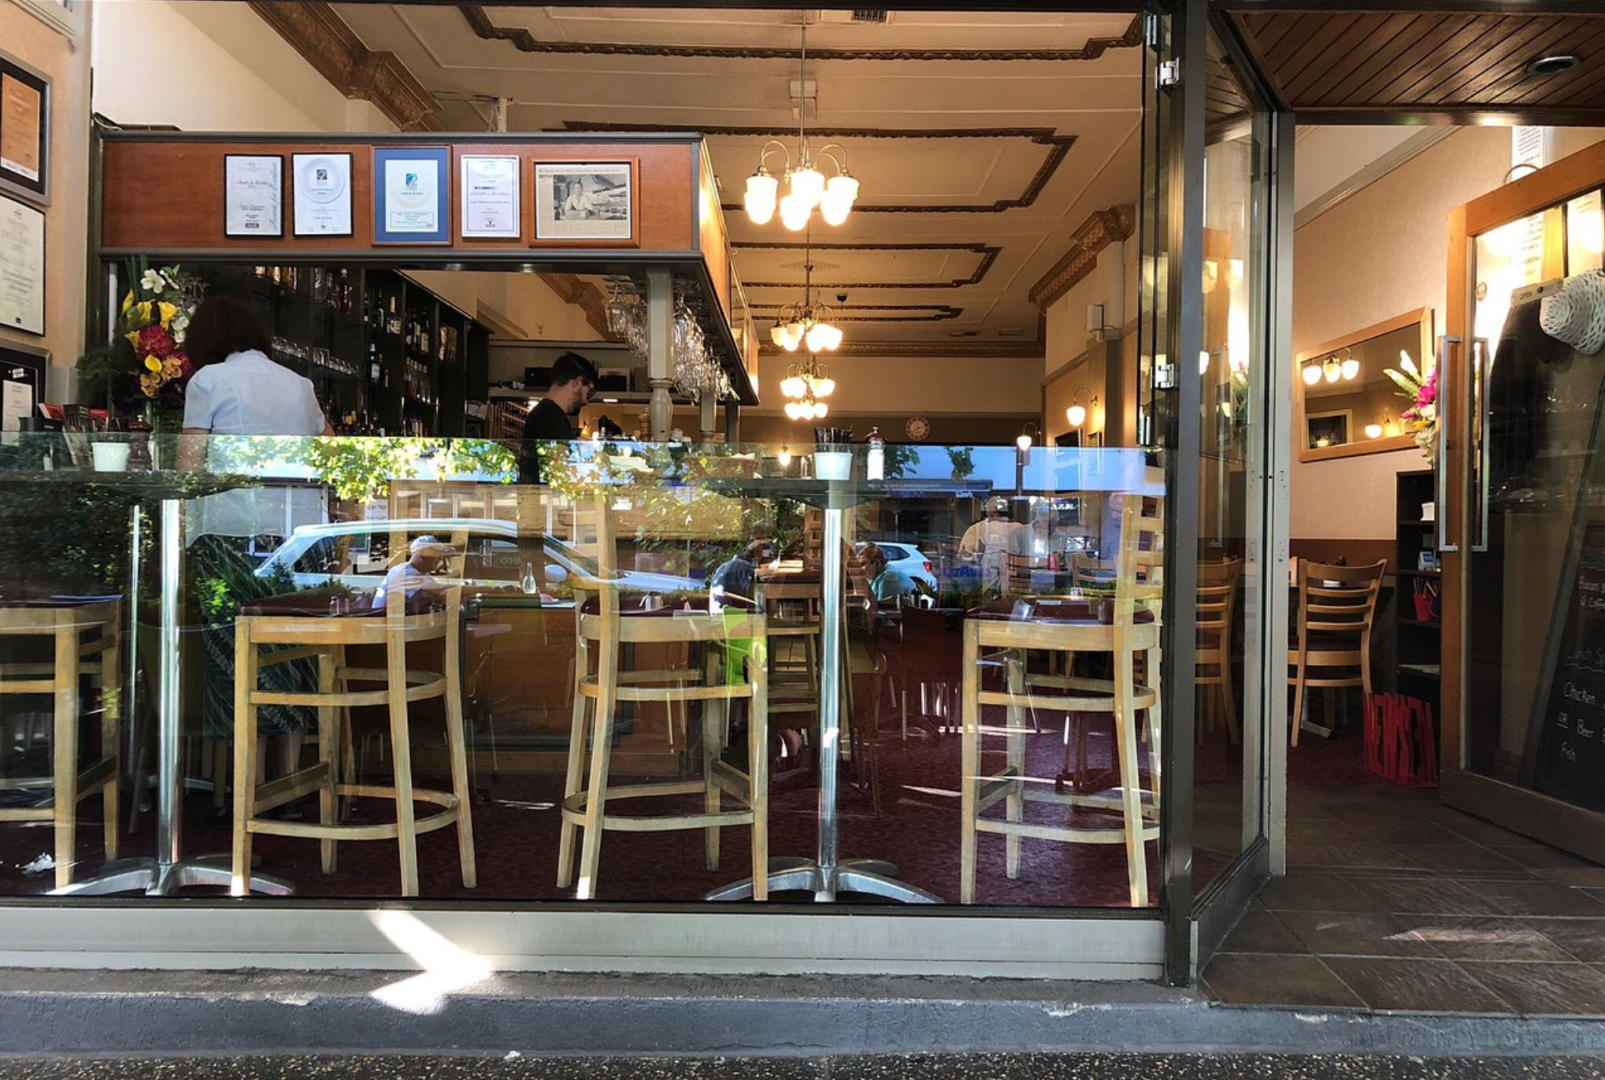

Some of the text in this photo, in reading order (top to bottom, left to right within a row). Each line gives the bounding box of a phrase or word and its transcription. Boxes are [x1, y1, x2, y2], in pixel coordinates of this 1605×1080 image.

[1563, 681, 1596, 706] Chicken
[1577, 718, 1595, 738] Beer
[1560, 742, 1577, 763] Fish
